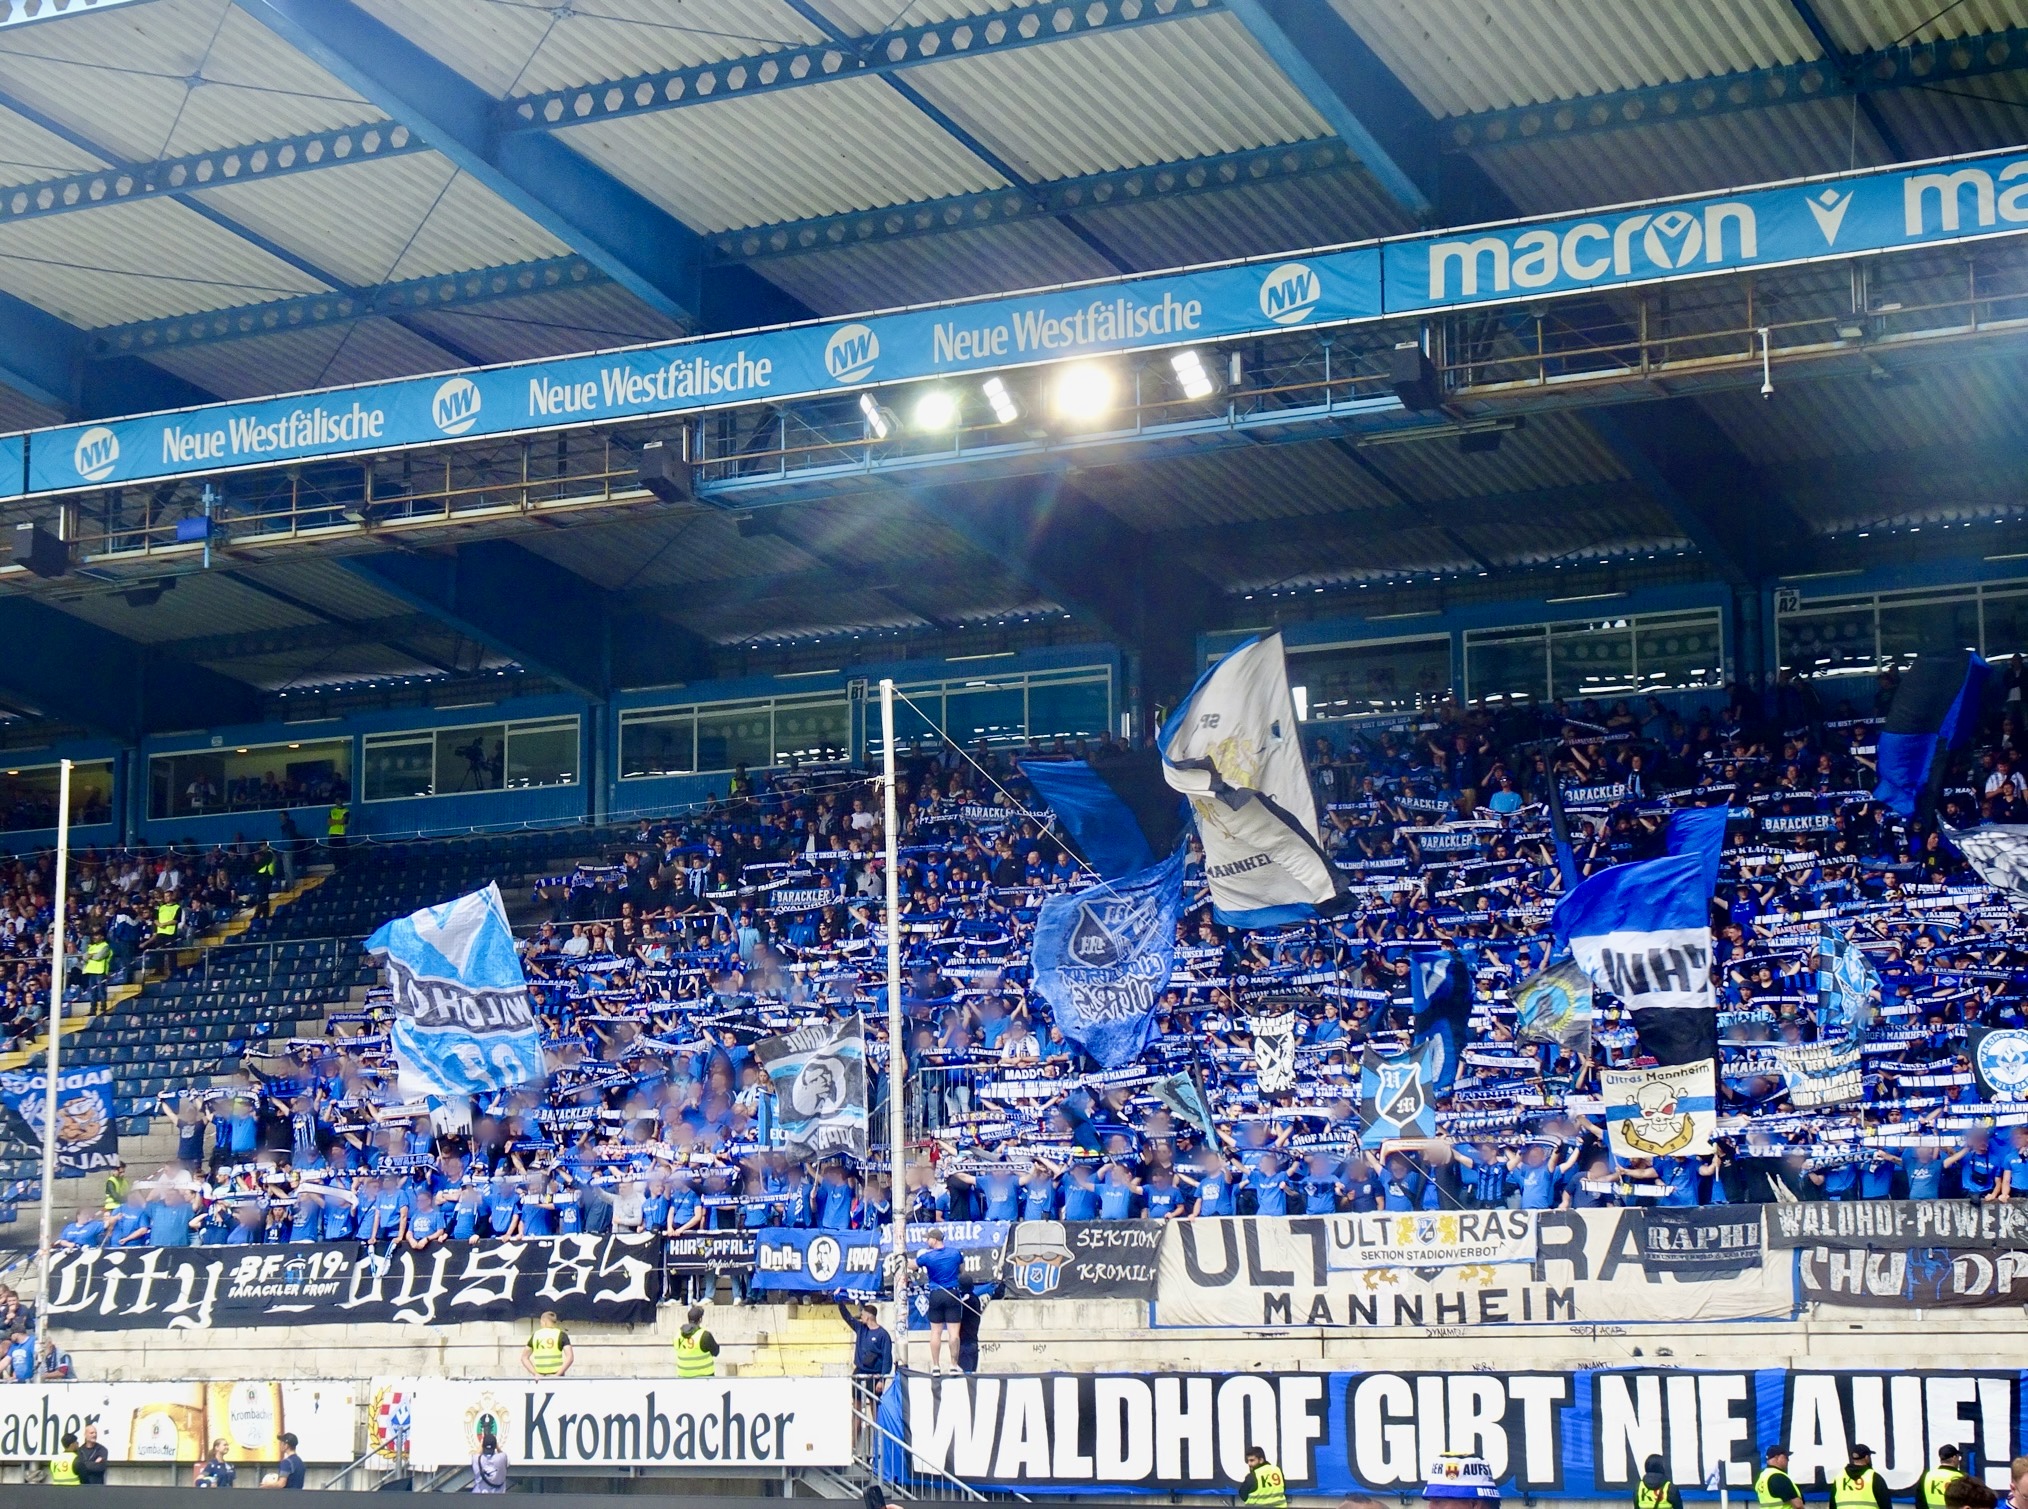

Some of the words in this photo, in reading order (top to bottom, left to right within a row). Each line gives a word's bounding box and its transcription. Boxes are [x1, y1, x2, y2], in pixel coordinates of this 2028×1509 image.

[1428, 202, 1757, 299] macron
[1268, 271, 1315, 314] NW
[934, 319, 1008, 363] Neue
[1016, 292, 1201, 349] Westfälische
[831, 334, 875, 373] NW
[529, 368, 593, 416] Neue
[601, 351, 772, 404] Westfälische
[437, 385, 478, 427] NW
[163, 426, 225, 464] Neue
[228, 403, 385, 454] Westfälische
[77, 435, 118, 473] NW
[1778, 597, 1797, 612] A2
[1370, 858, 1406, 868] MANNHEIM
[777, 889, 830, 902] BARACKLER
[1606, 1075, 1642, 1085] Ultras
[1646, 1065, 1710, 1081] Mannheim
[1951, 1104, 1994, 1113] WALDHOF
[1076, 1227, 1161, 1251] SEKTION
[1333, 1215, 1392, 1251] ULT
[1458, 1210, 1530, 1243] RAS
[1647, 1222, 1760, 1251] RAPHI
[1361, 1249, 1404, 1261] SEKTION
[1406, 1246, 1499, 1260] STADIONVERBOT
[538, 1232, 654, 1303] 85
[302, 1281, 340, 1297] FRONT
[1263, 1286, 1576, 1325] MANNHEIM
[534, 1337, 557, 1351] K9
[677, 1336, 696, 1351] K9
[231, 1410, 273, 1422] Krombacher
[523, 1391, 794, 1462] Krombacher
[911, 1375, 1323, 1483] WALDHOF
[1354, 1373, 1566, 1485] GIBT
[1601, 1374, 1752, 1486] NIE
[1788, 1374, 2011, 1490] AUF!
[53, 1462, 69, 1473] K9
[1260, 1472, 1282, 1490] K9
[1841, 1477, 1865, 1491] K9
